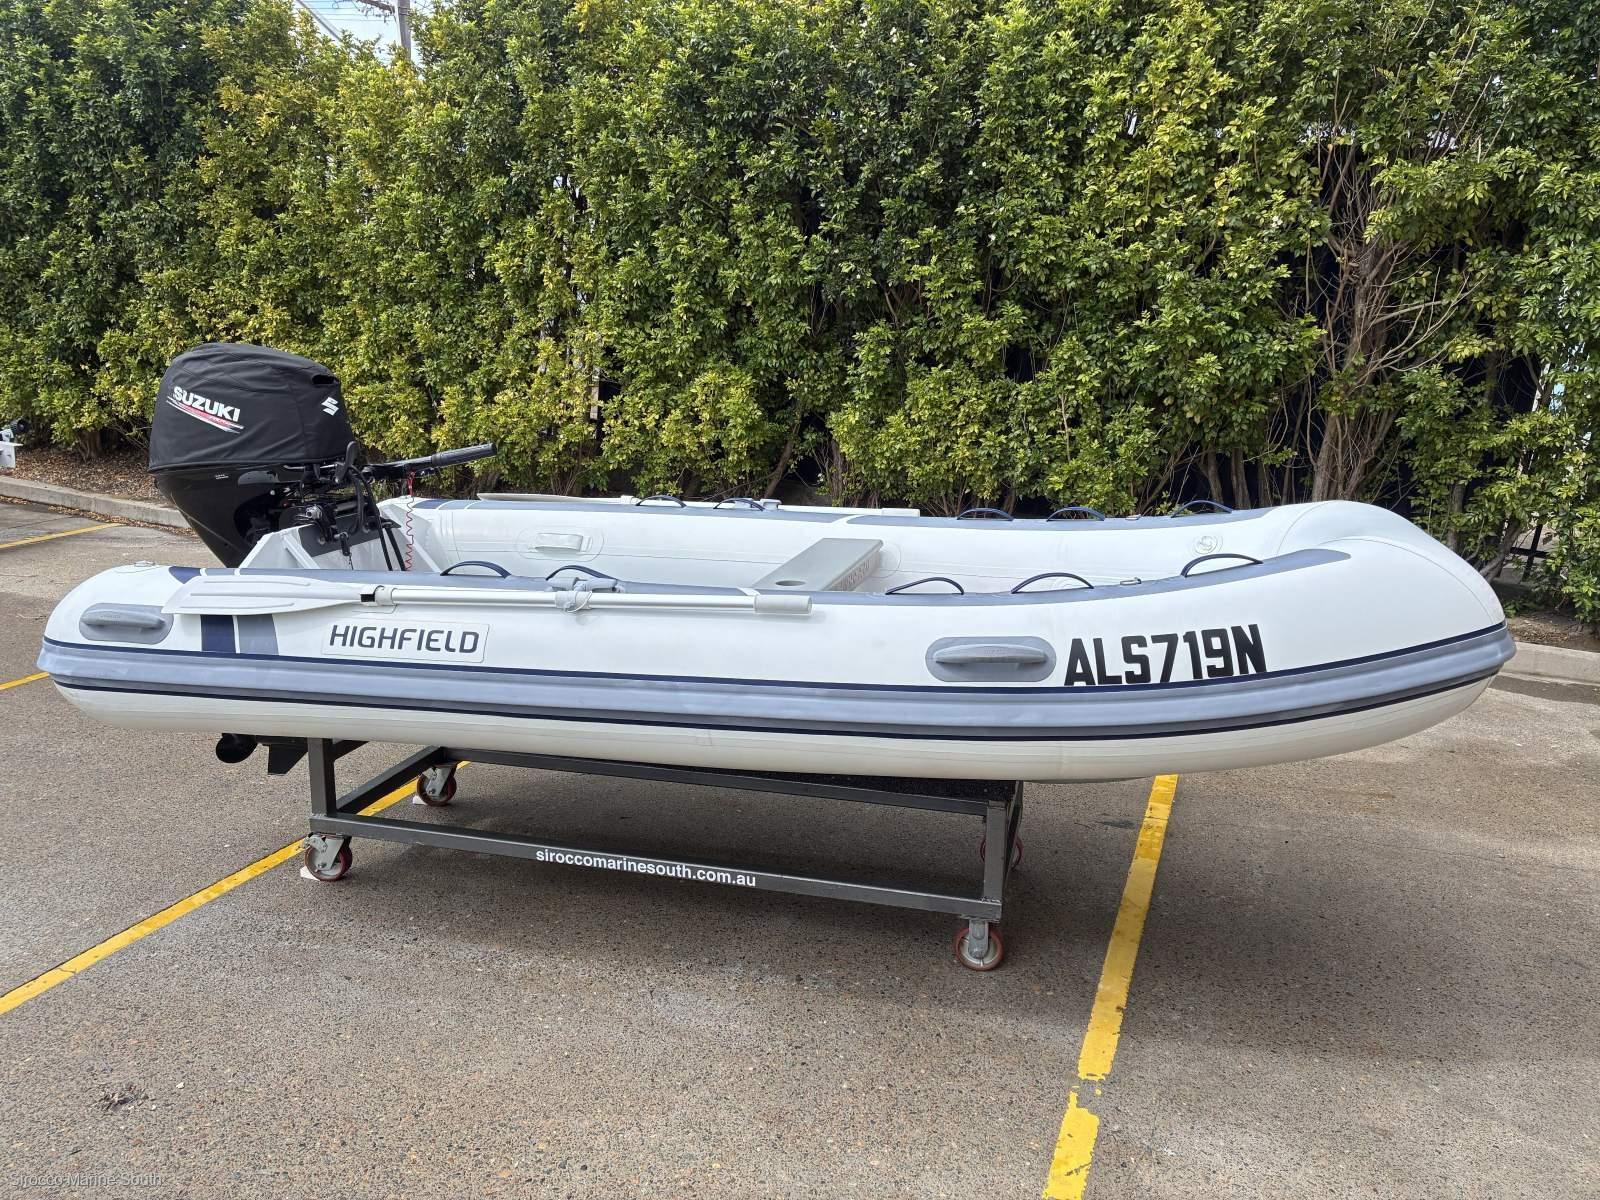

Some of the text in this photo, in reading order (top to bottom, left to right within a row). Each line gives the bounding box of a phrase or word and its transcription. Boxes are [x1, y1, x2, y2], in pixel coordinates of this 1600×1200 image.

[172, 386, 241, 422] SUZUKI
[329, 624, 480, 654] HIGHFIELD
[1064, 624, 1267, 686] ALS719N
[535, 849, 757, 887] siroccomarinesouth.com.au
